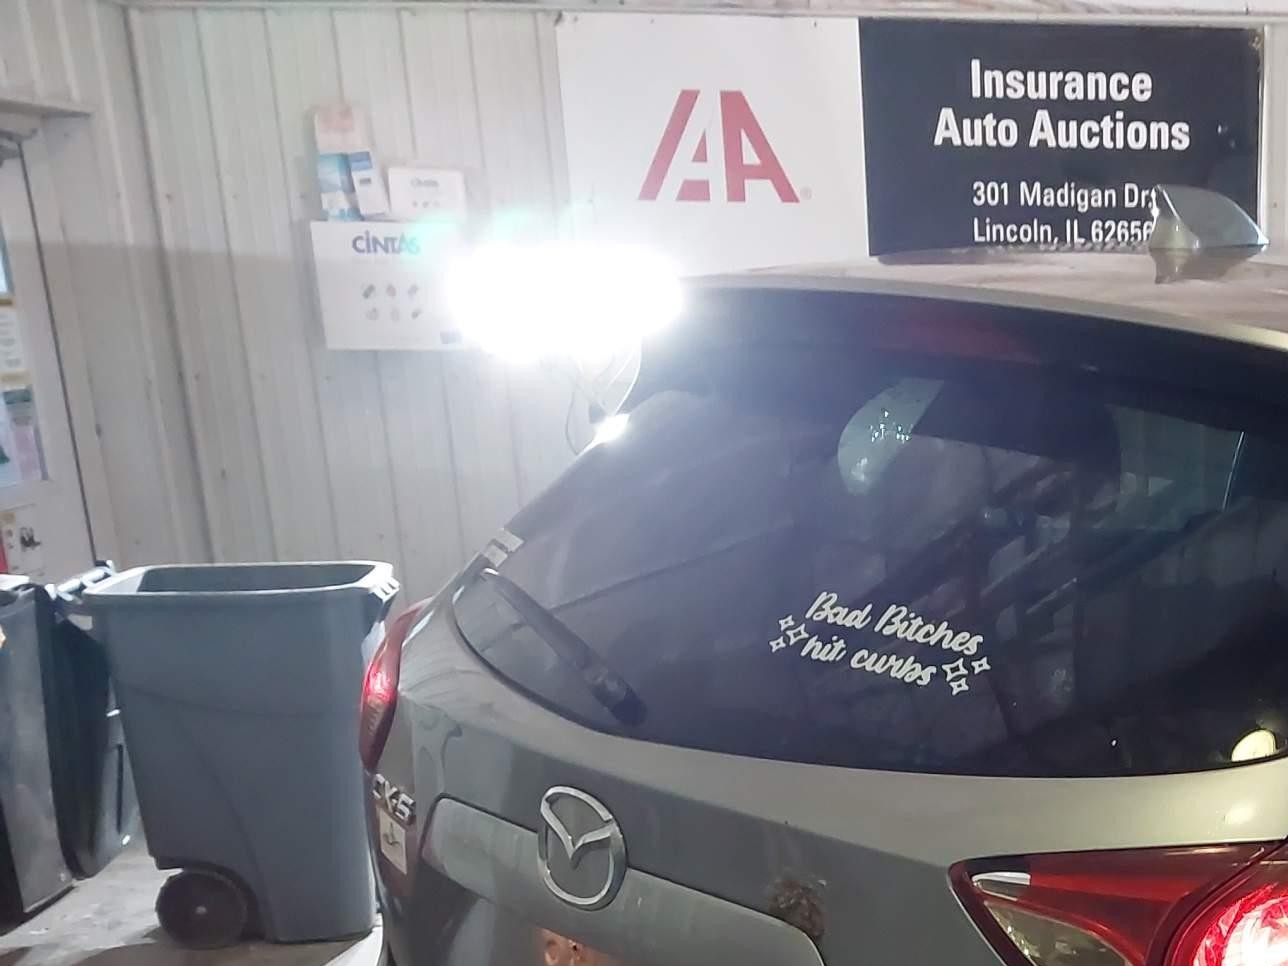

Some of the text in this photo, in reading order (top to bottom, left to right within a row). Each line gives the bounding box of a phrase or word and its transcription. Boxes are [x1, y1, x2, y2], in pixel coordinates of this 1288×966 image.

[970, 58, 1153, 102] Insurance
[933, 107, 1191, 151] Auto Auctions
[972, 181, 1009, 206] 301
[1019, 181, 1117, 212] Madigan
[973, 217, 1059, 244] Lincoln,
[1066, 219, 1085, 244] IL
[805, 591, 983, 655] Bad Bitches
[851, 649, 936, 685] curbs
